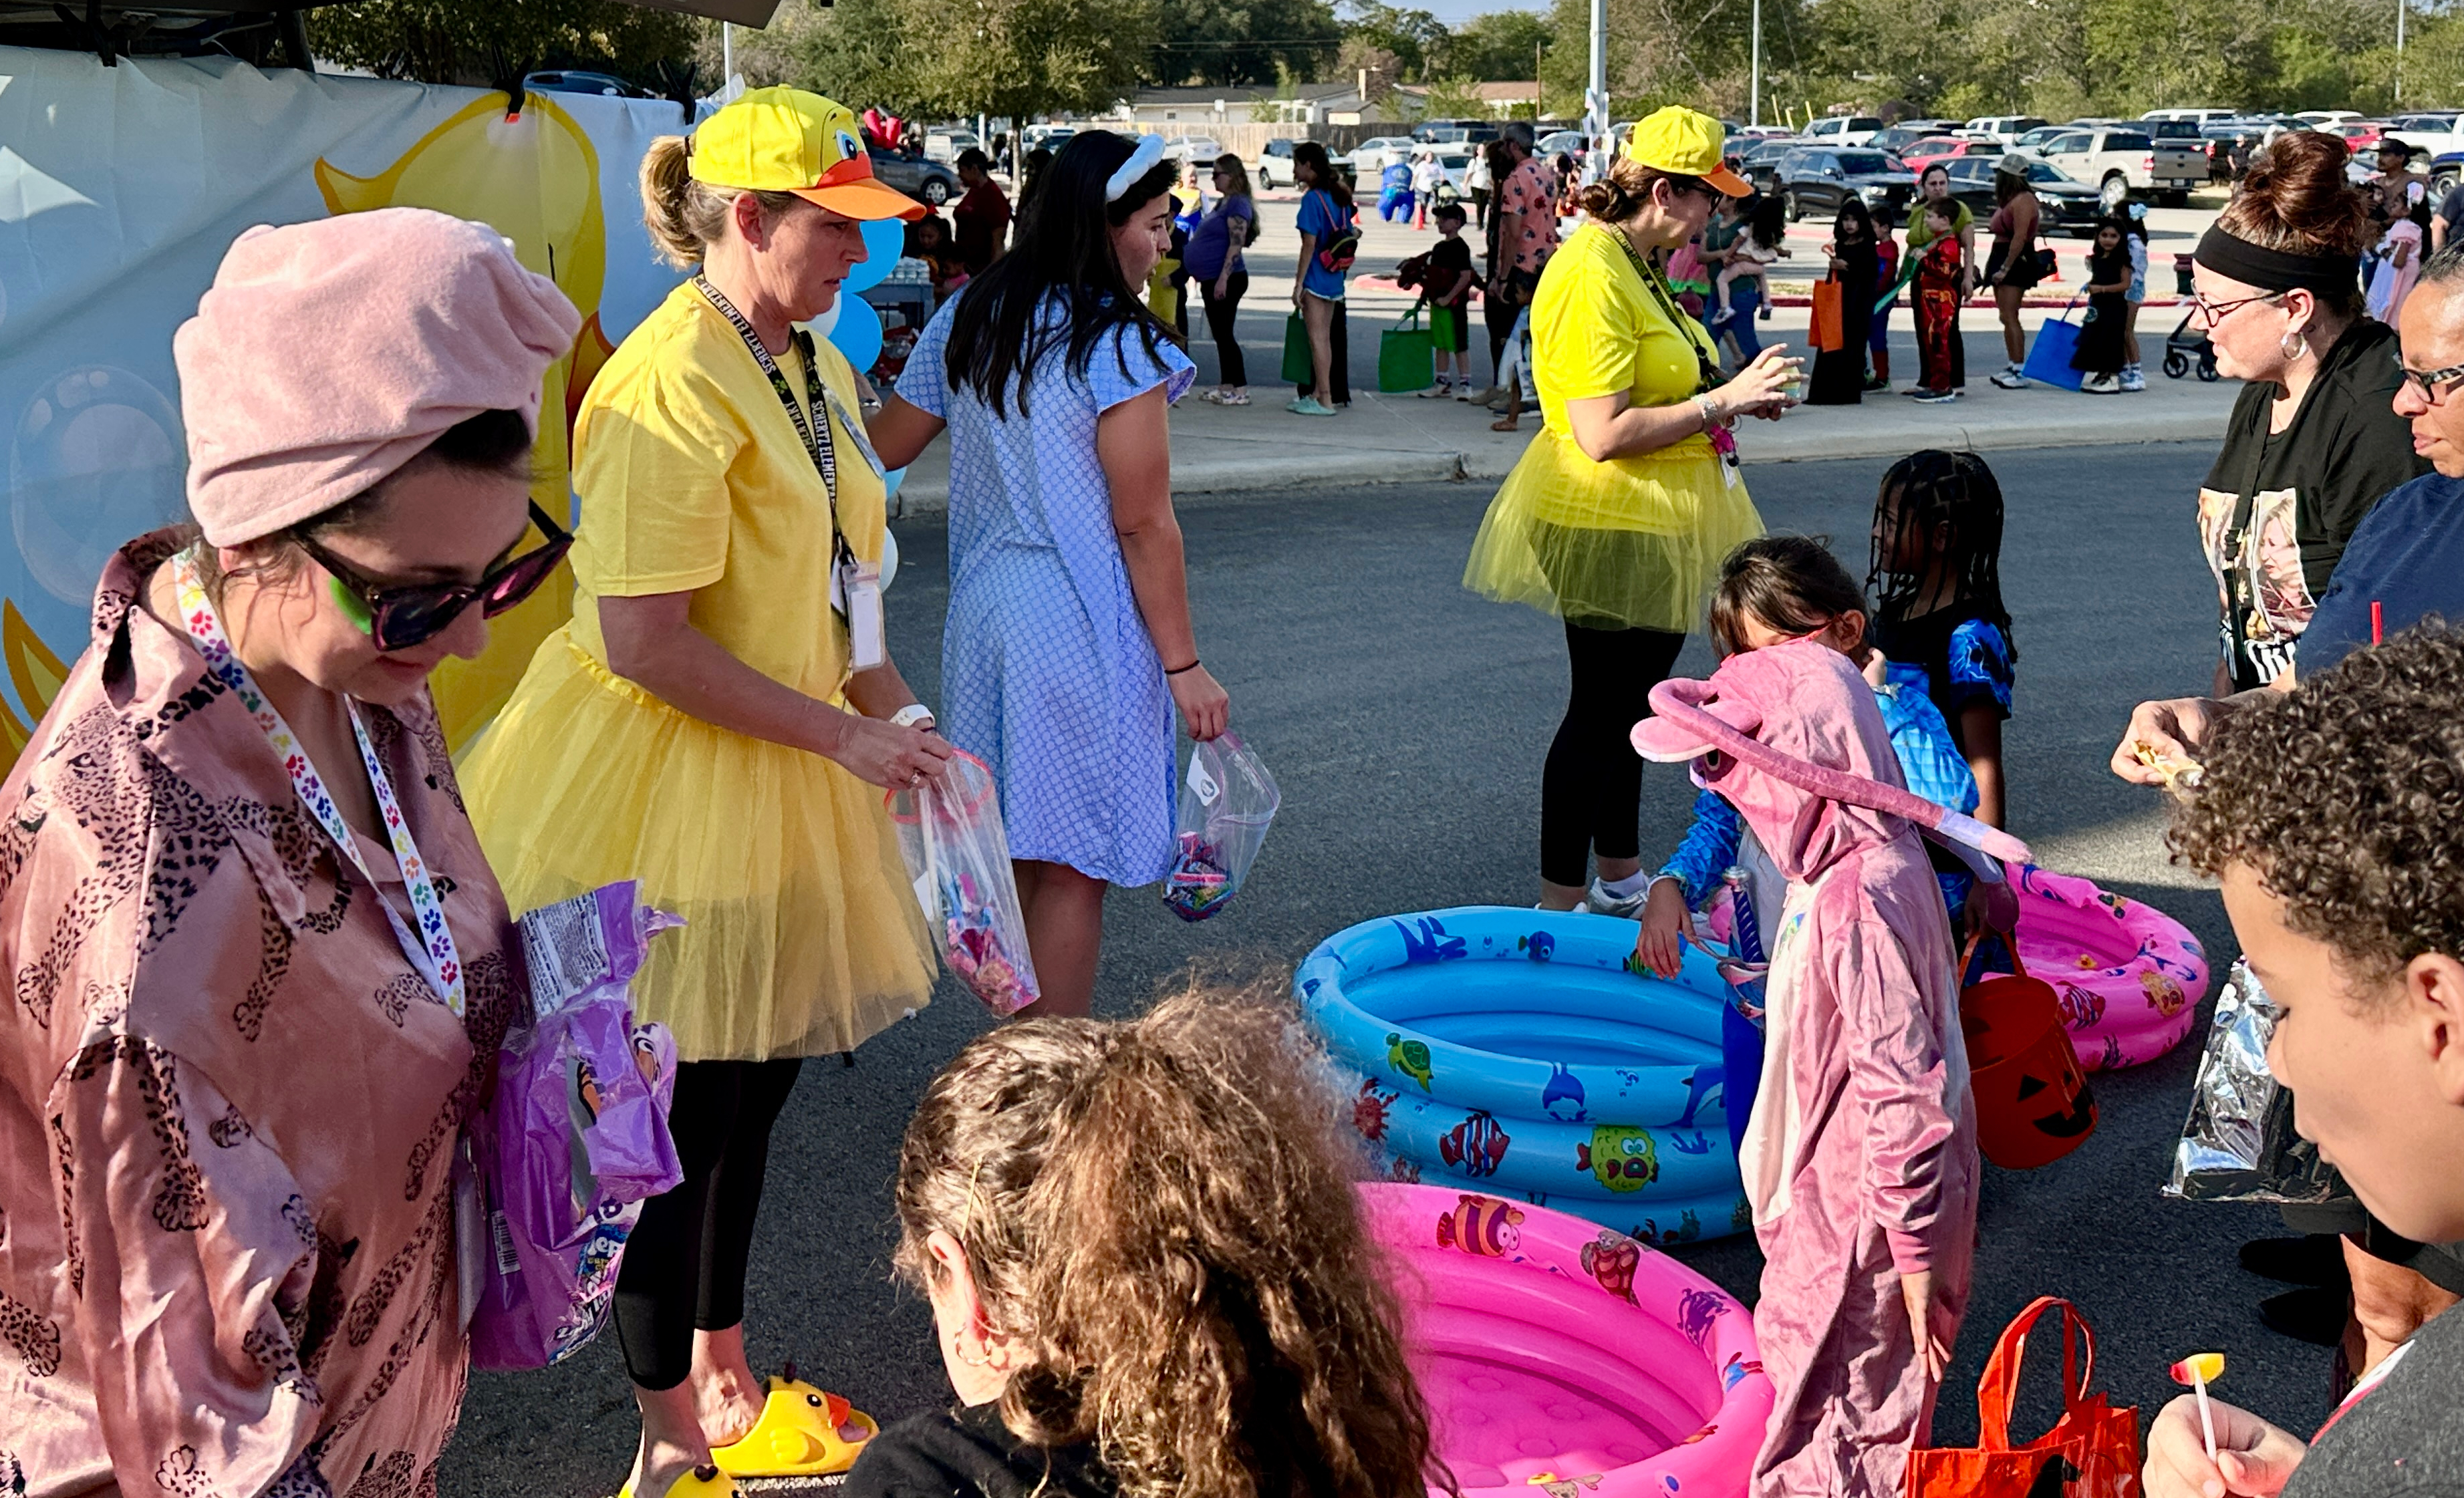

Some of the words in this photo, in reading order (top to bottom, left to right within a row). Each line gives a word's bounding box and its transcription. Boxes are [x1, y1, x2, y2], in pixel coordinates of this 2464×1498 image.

[700, 282, 750, 332] ELEMENTARY
[742, 330, 777, 374] SCHERTZ
[811, 401, 831, 449] SCHERTZ
